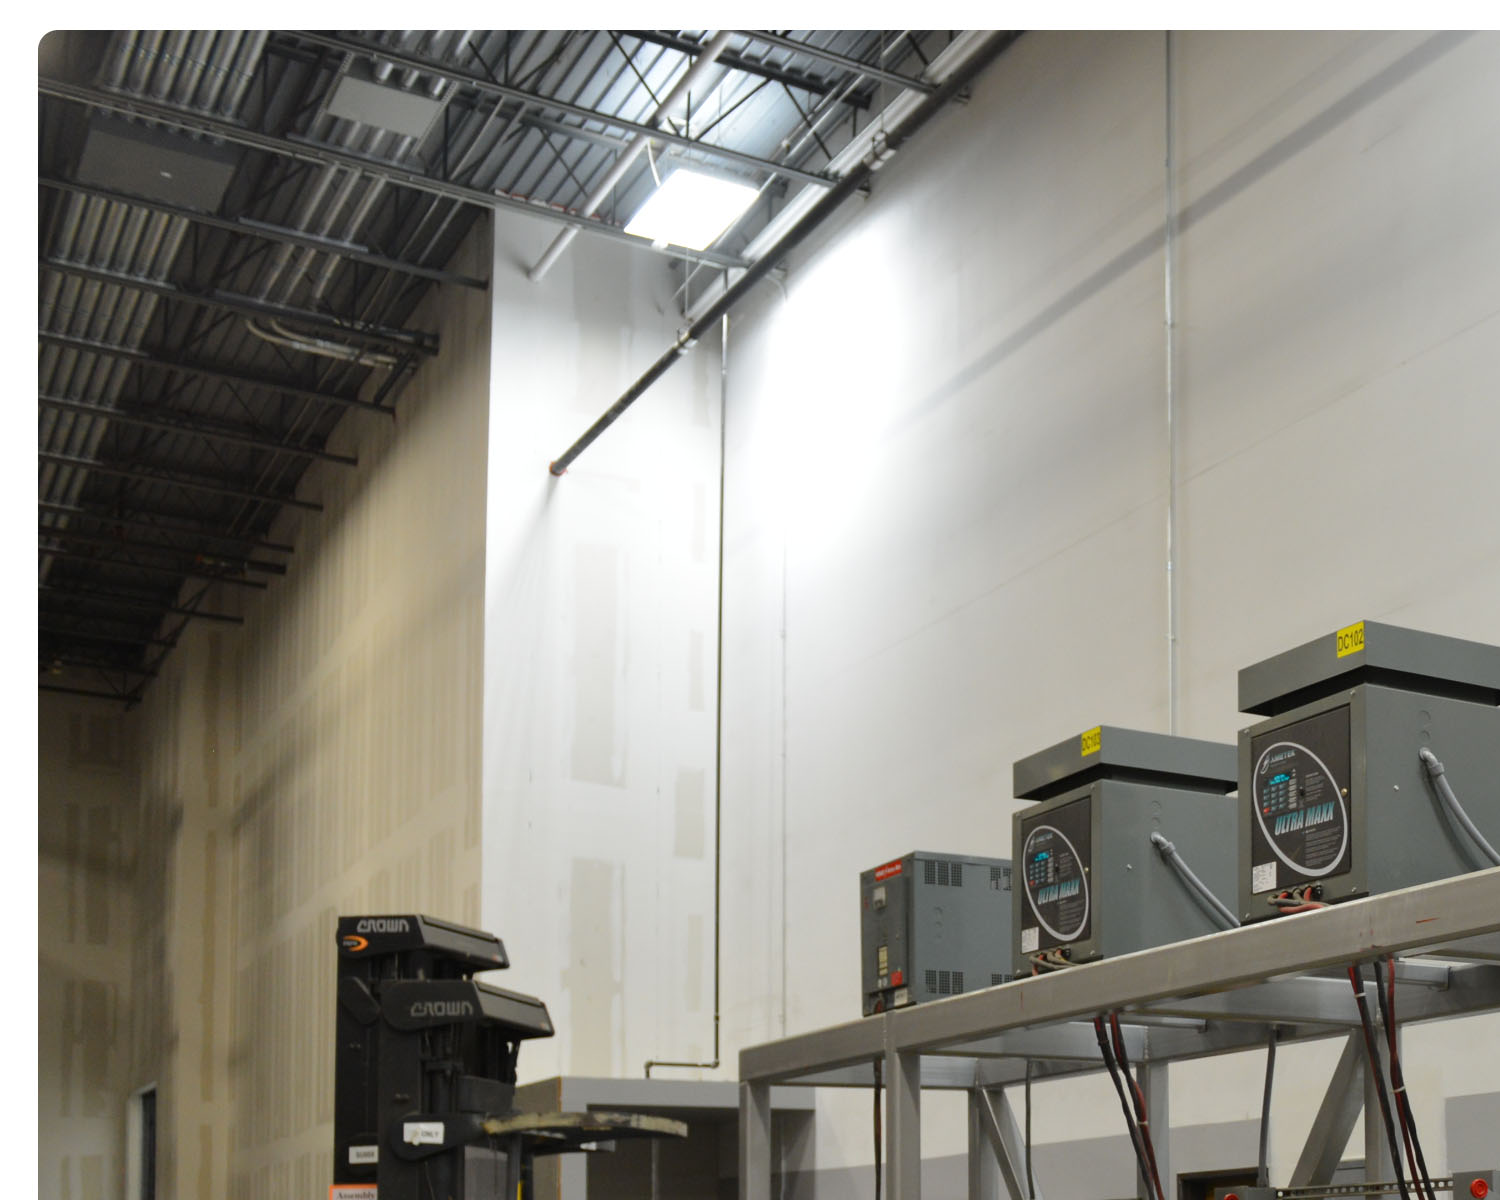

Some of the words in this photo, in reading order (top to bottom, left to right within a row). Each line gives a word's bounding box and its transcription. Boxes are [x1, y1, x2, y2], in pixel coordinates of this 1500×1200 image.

[1338, 628, 1363, 652] DC102
[1274, 809, 1304, 836] ULTRA
[1304, 801, 1335, 827] MAXX
[356, 919, 410, 933] CROWN
[410, 1001, 474, 1017] CROWN
[337, 1191, 375, 1200] Assembly
